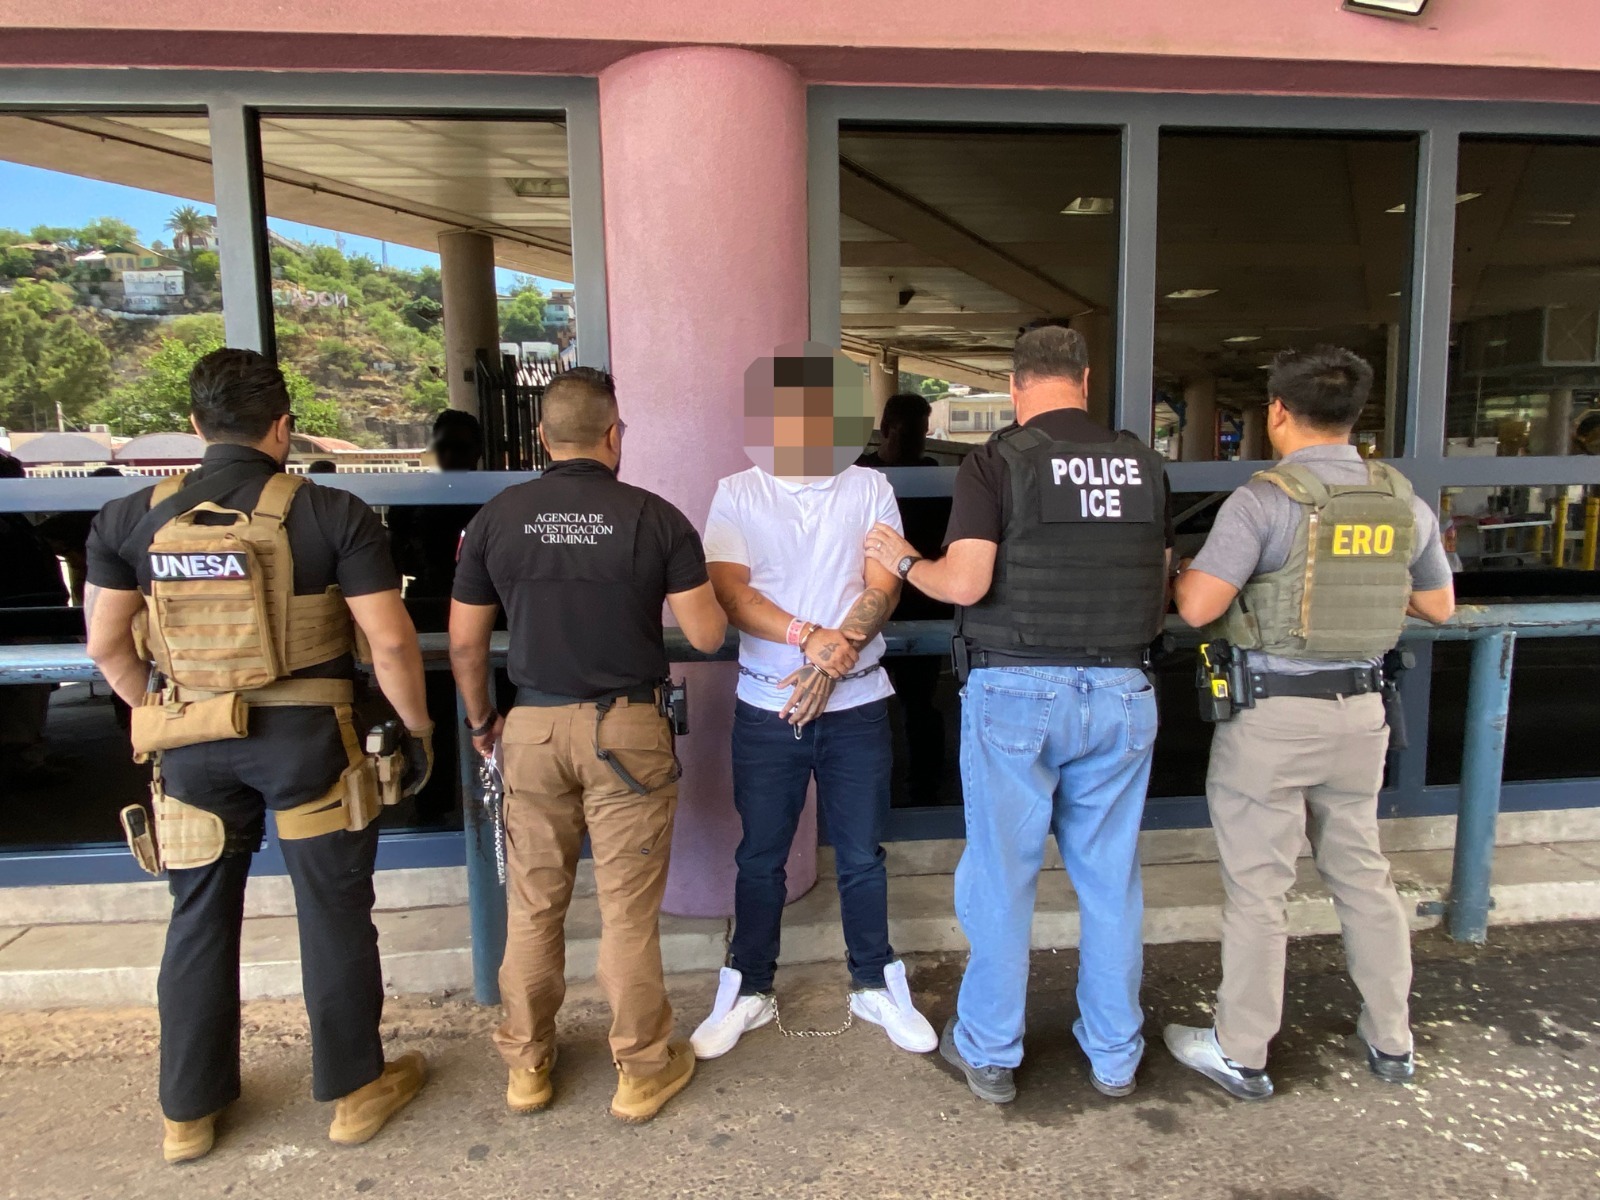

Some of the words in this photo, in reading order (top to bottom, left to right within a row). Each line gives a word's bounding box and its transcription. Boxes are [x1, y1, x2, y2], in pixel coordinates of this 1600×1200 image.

[1051, 457, 1142, 485] POLICE
[1080, 489, 1121, 518] ICE
[524, 524, 613, 534] INVESTIGACIÓN
[535, 513, 587, 523] AGENCIA
[588, 514, 604, 523] DE
[541, 534, 598, 544] CRIMINAL
[1333, 525, 1394, 554] ERO
[151, 555, 245, 577] UNESA
